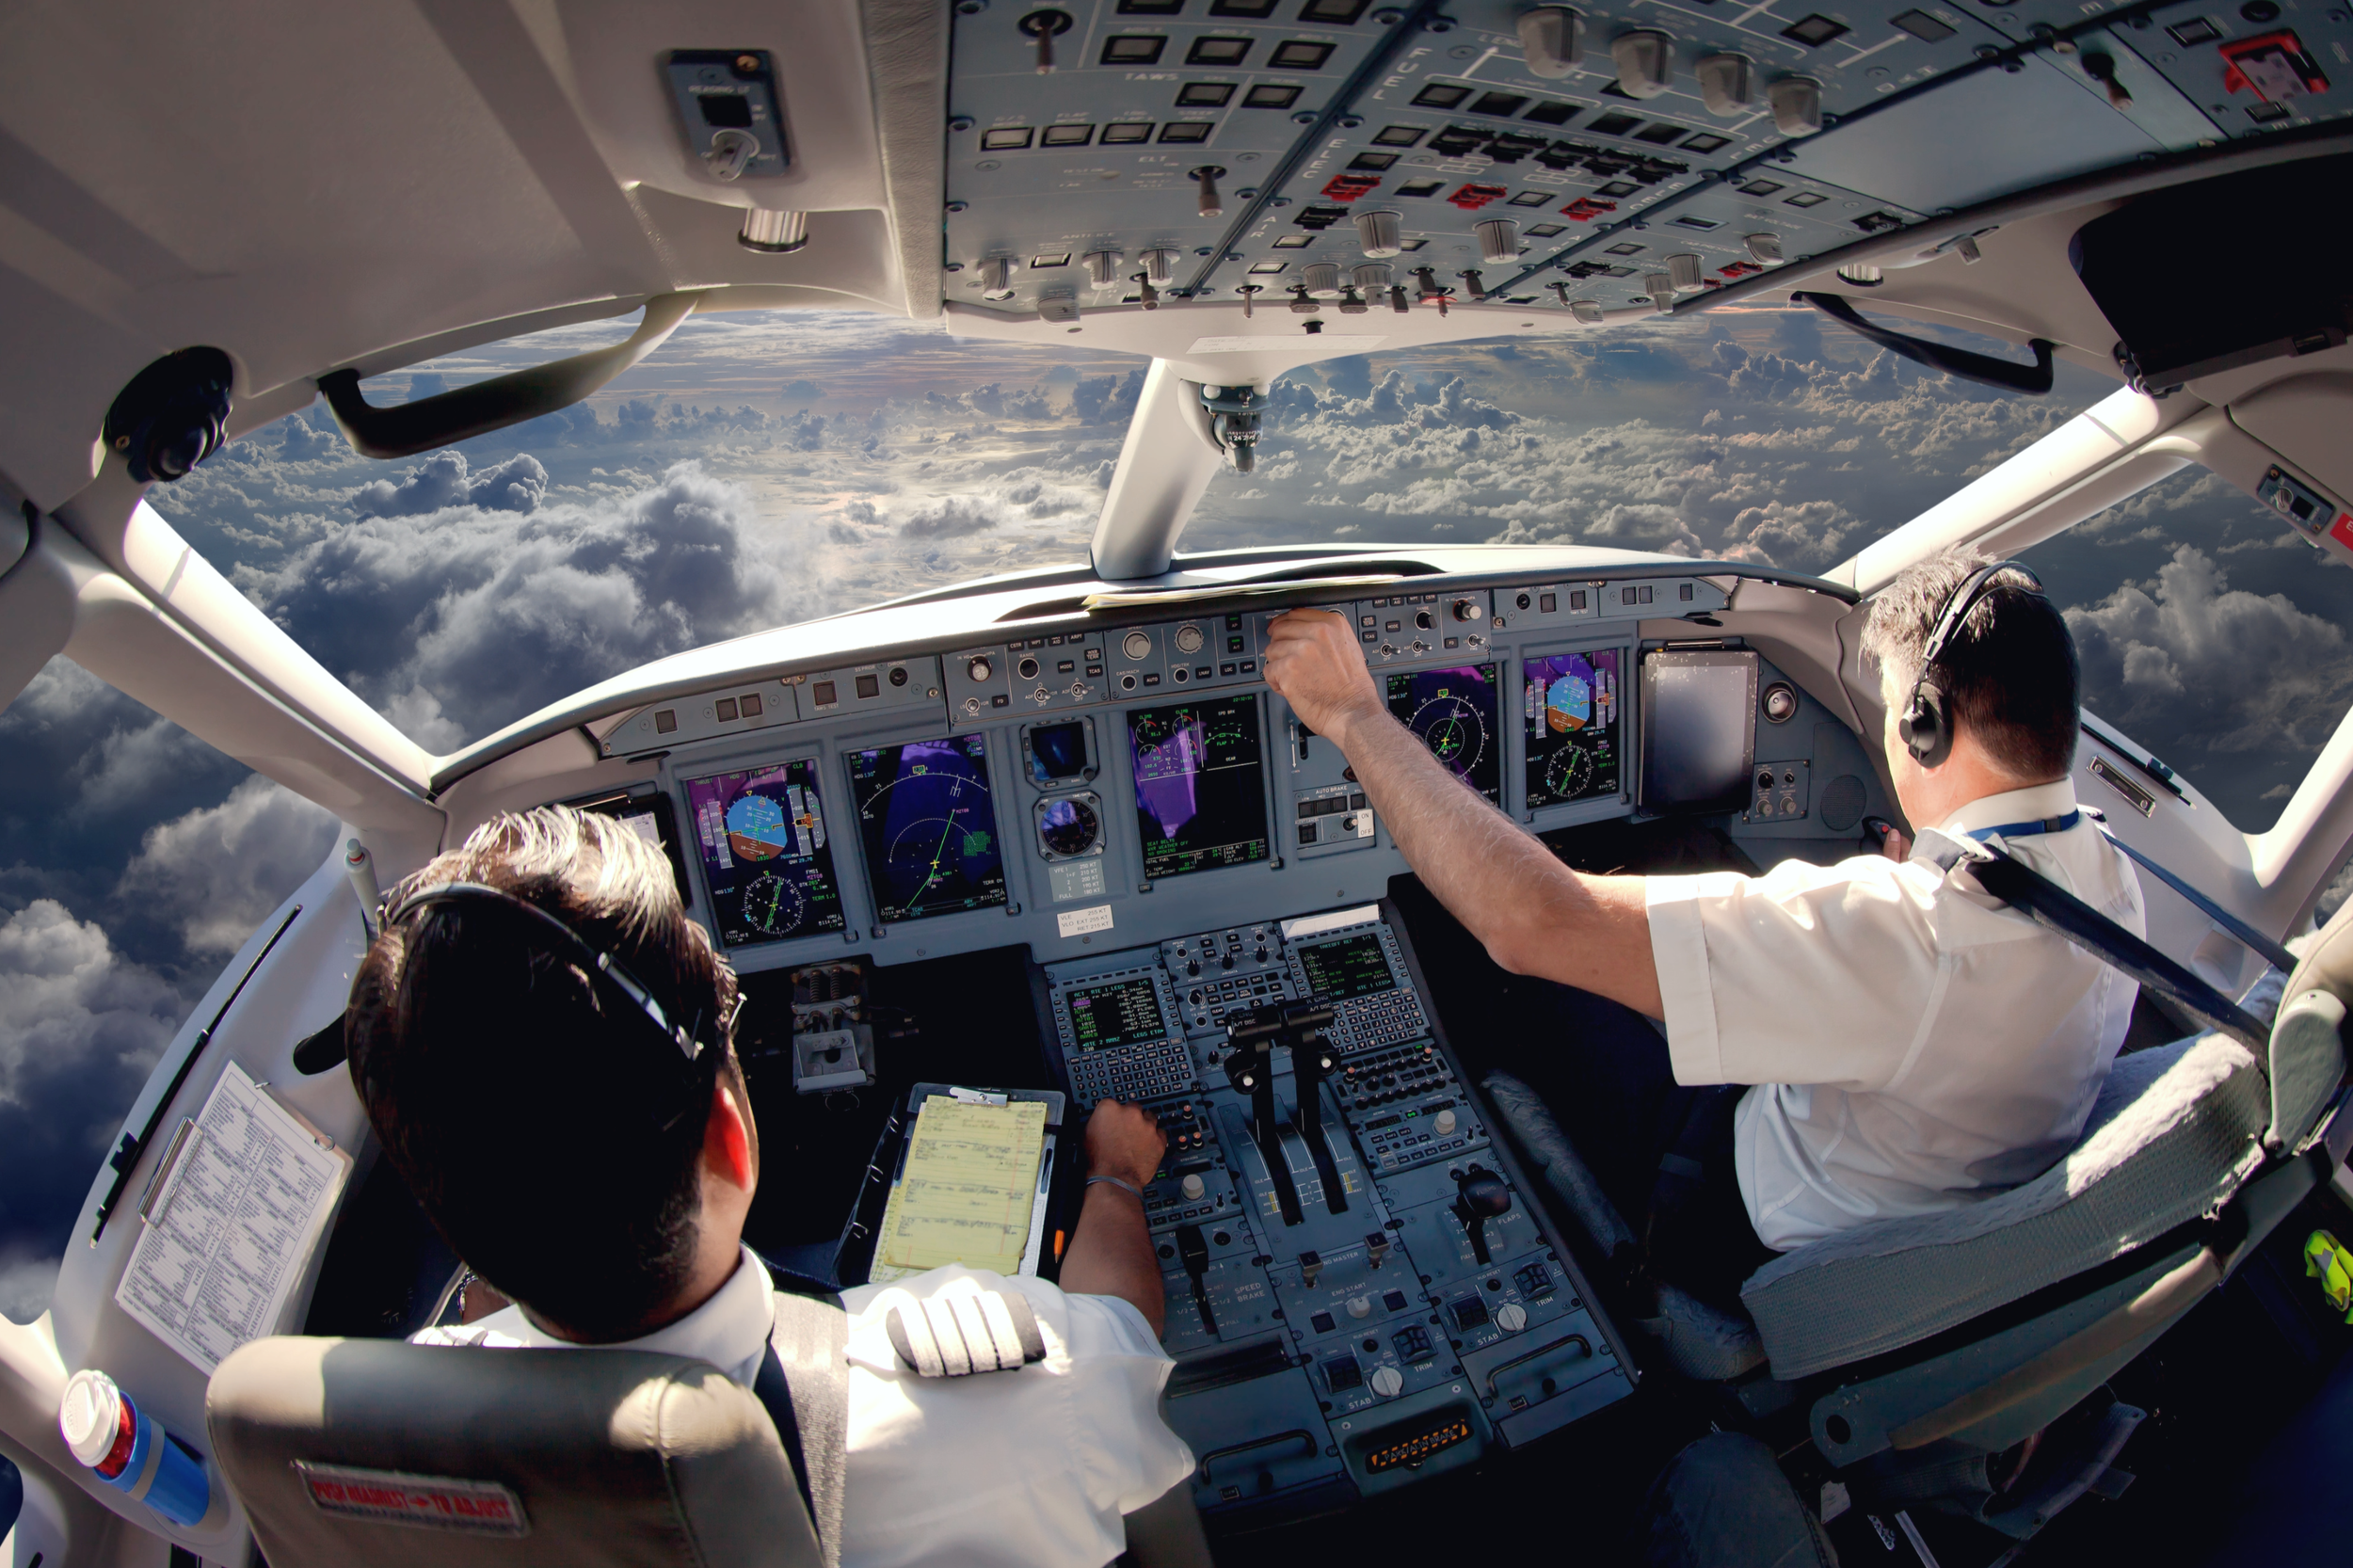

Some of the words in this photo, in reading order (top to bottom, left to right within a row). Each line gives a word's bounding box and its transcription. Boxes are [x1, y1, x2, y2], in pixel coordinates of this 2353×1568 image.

[1125, 72, 1179, 81] TAWS
[1372, 47, 1433, 101] FUEL
[1729, 135, 1781, 161] UEL
[1303, 138, 1349, 179] ELEC
[1476, 1186, 1497, 1196] FLAPS
[1497, 1213, 1522, 1225] FLAPS
[1333, 1251, 1359, 1263] MASTER
[1235, 1282, 1261, 1294] SPEED
[1331, 1288, 1345, 1297] ENG
[1346, 1283, 1366, 1293] START
[1237, 1290, 1265, 1303] BRAKE
[1535, 1296, 1554, 1307] TRIM
[1478, 1333, 1499, 1346] STAB
[1414, 1362, 1433, 1373] TRIM
[1348, 1398, 1371, 1410] STAB
[1385, 1440, 1429, 1461] PARK/ALTN
[1430, 1430, 1455, 1444] BRAKE
